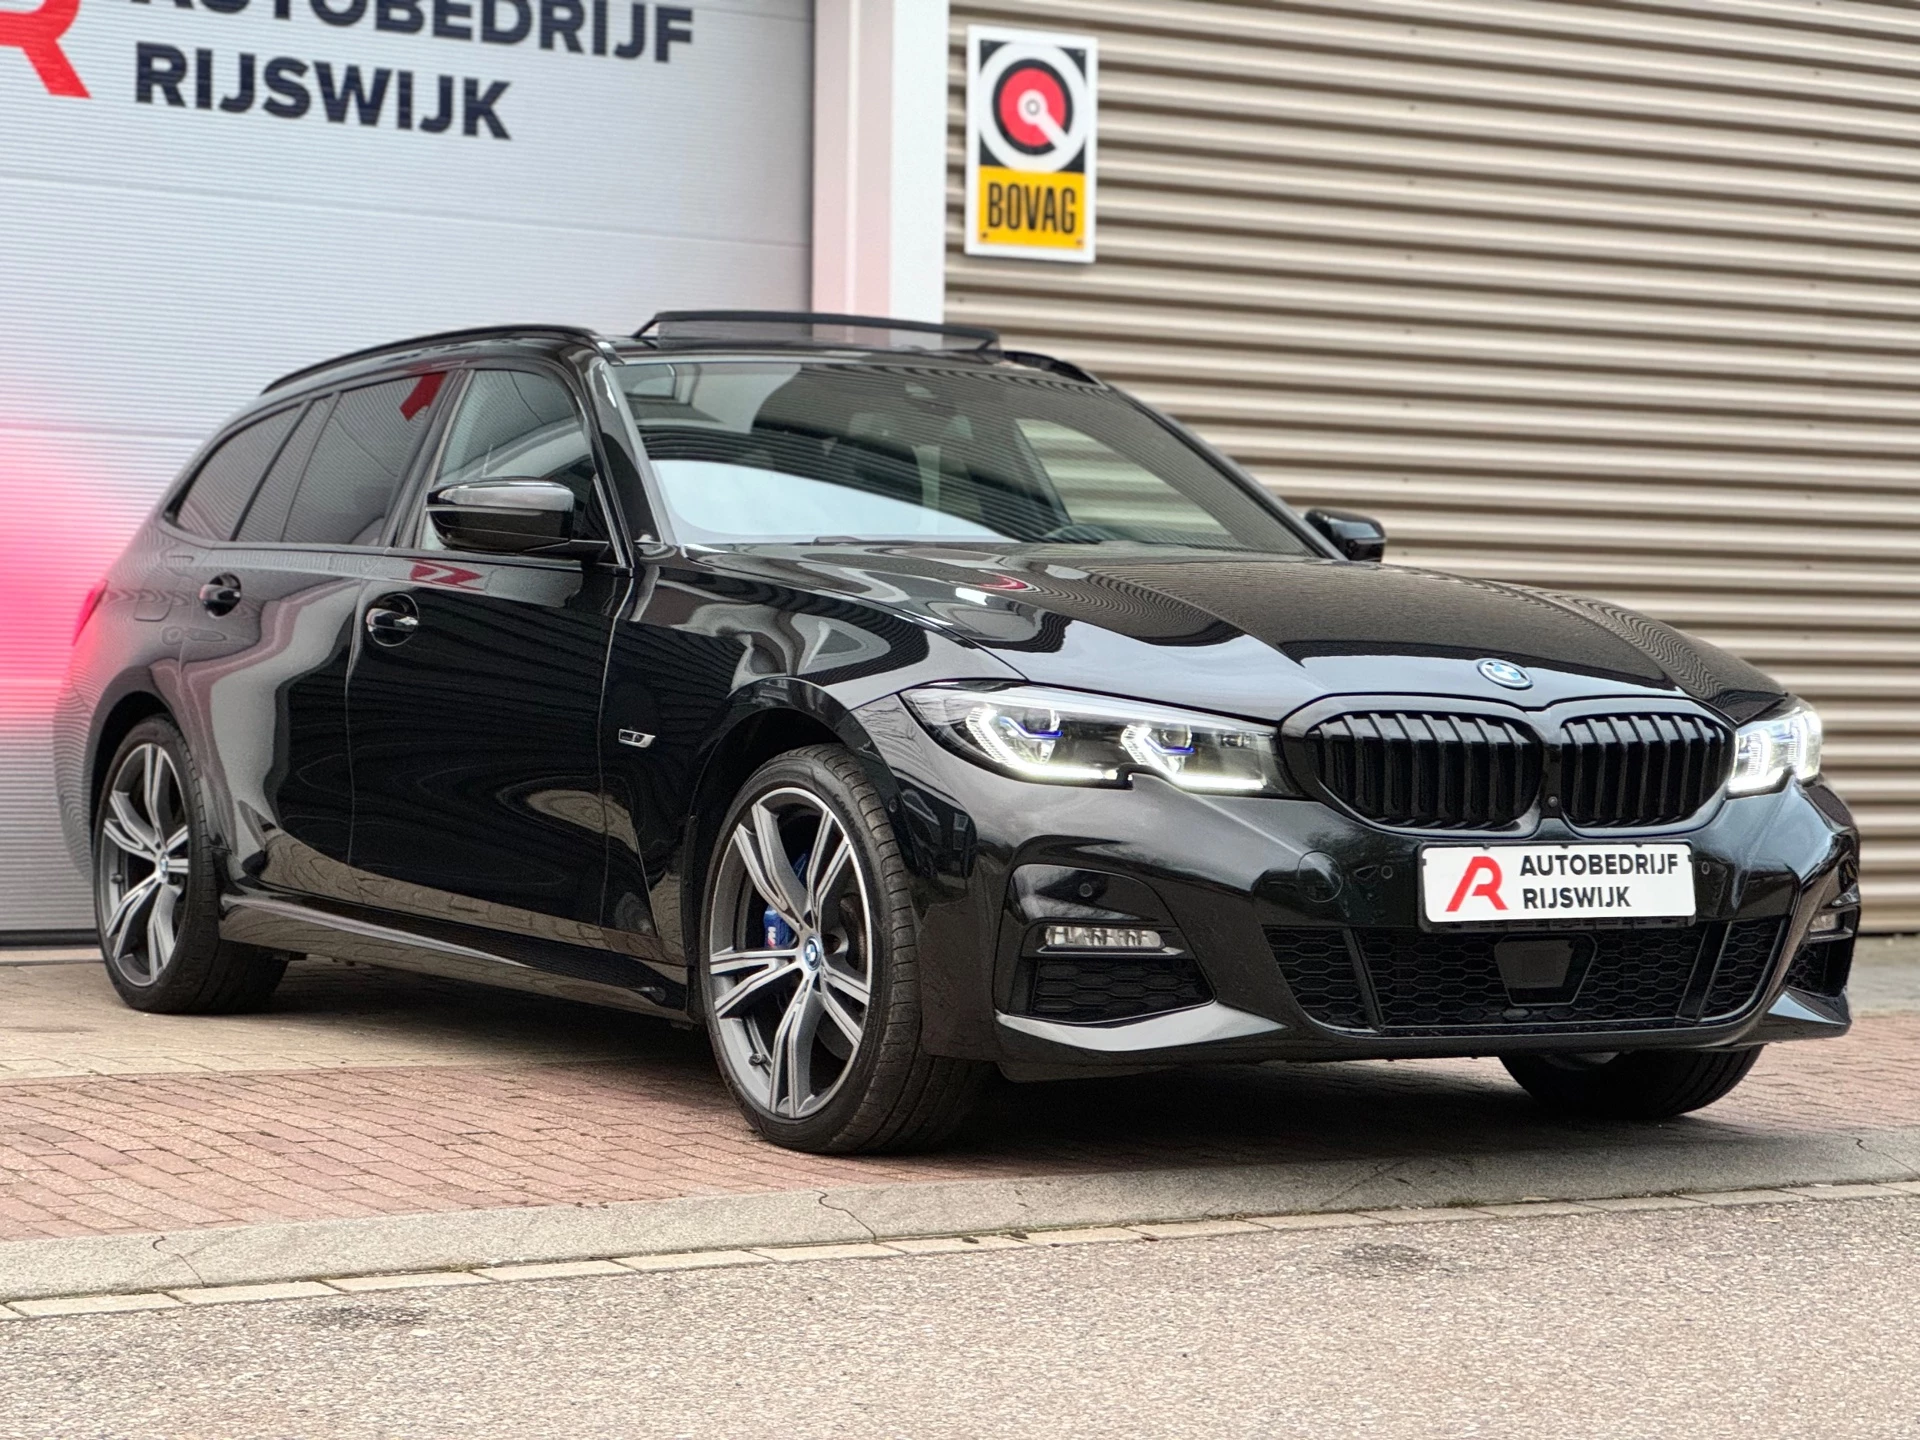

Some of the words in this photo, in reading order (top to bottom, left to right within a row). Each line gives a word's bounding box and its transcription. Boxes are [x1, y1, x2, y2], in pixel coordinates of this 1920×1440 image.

[130, 0, 693, 63] BEDRIJF
[136, 41, 512, 140] RIJSWIJK
[987, 182, 1077, 235] BOVAG
[1520, 853, 1679, 877] AUTOBEDRIJF
[1523, 886, 1632, 910] RIJSWIJK
